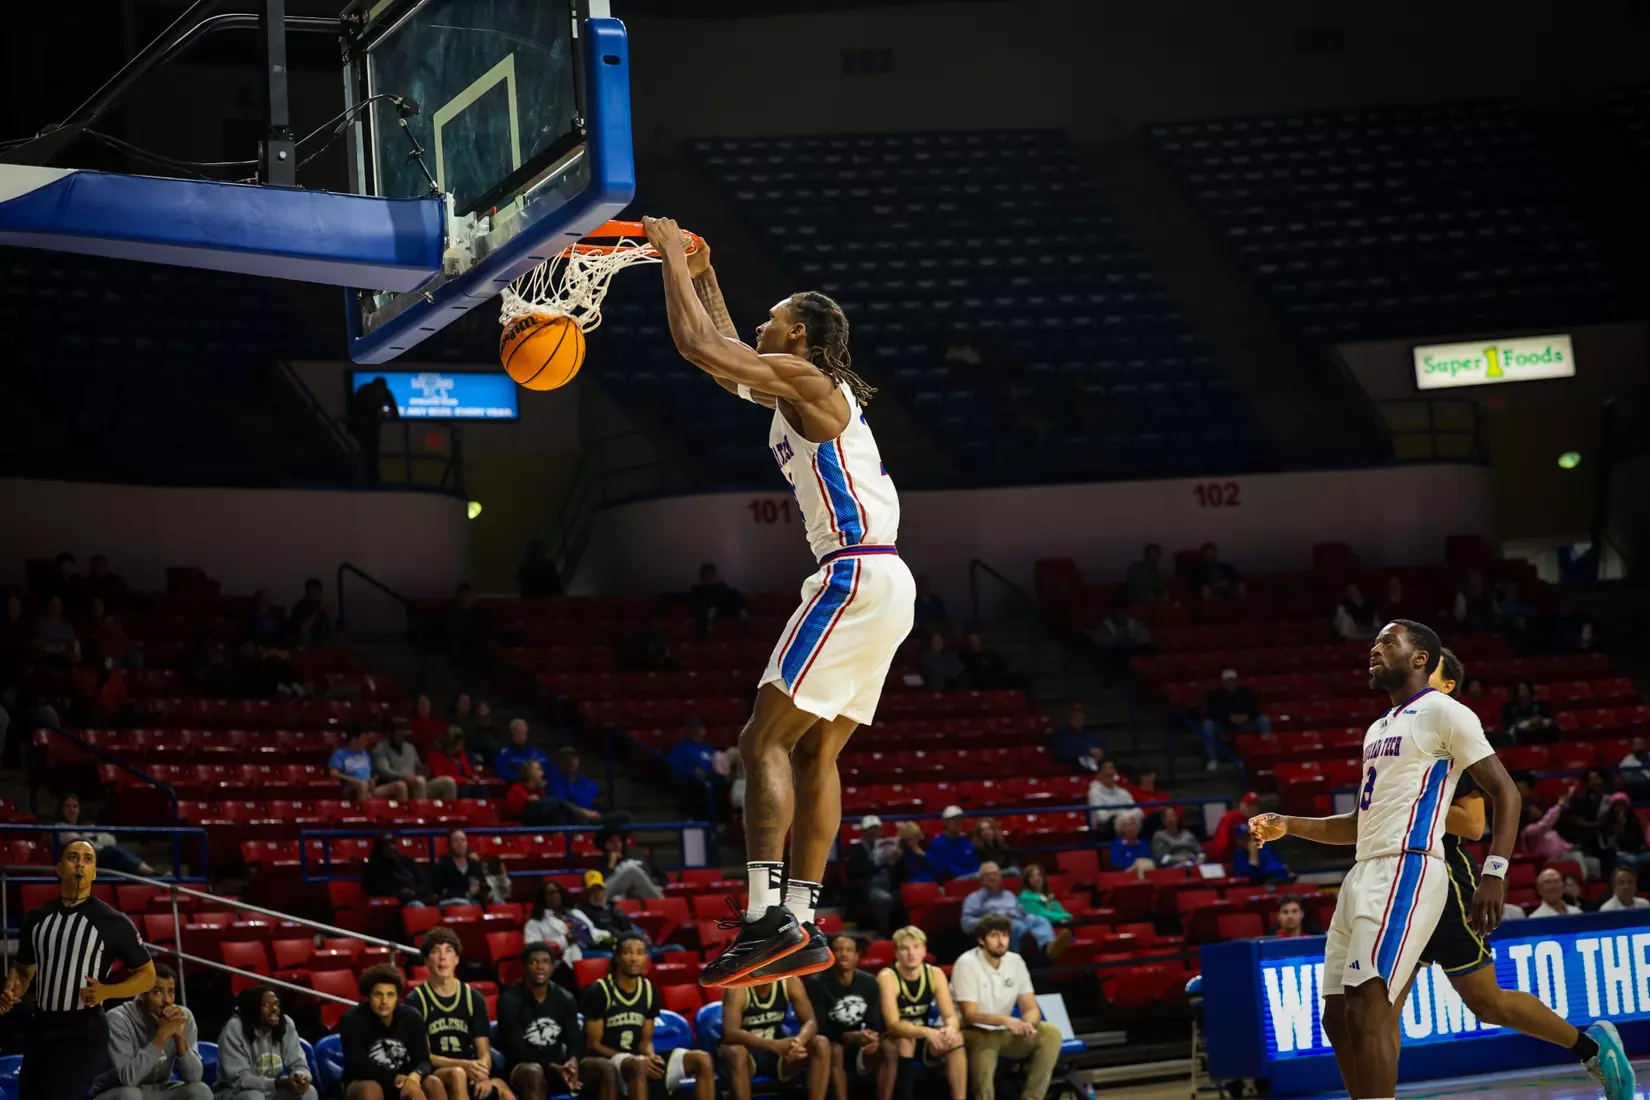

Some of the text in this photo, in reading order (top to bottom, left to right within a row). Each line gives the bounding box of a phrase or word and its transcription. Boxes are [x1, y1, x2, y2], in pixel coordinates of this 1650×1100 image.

[1423, 345, 1565, 378] Super 1 Foods
[1192, 482, 1243, 508] 102
[746, 499, 792, 524] 101
[1381, 736, 1403, 756] TECH
[1360, 766, 1377, 812] 3
[1508, 940, 1569, 1019] TO
[1575, 933, 1650, 1018] THE
